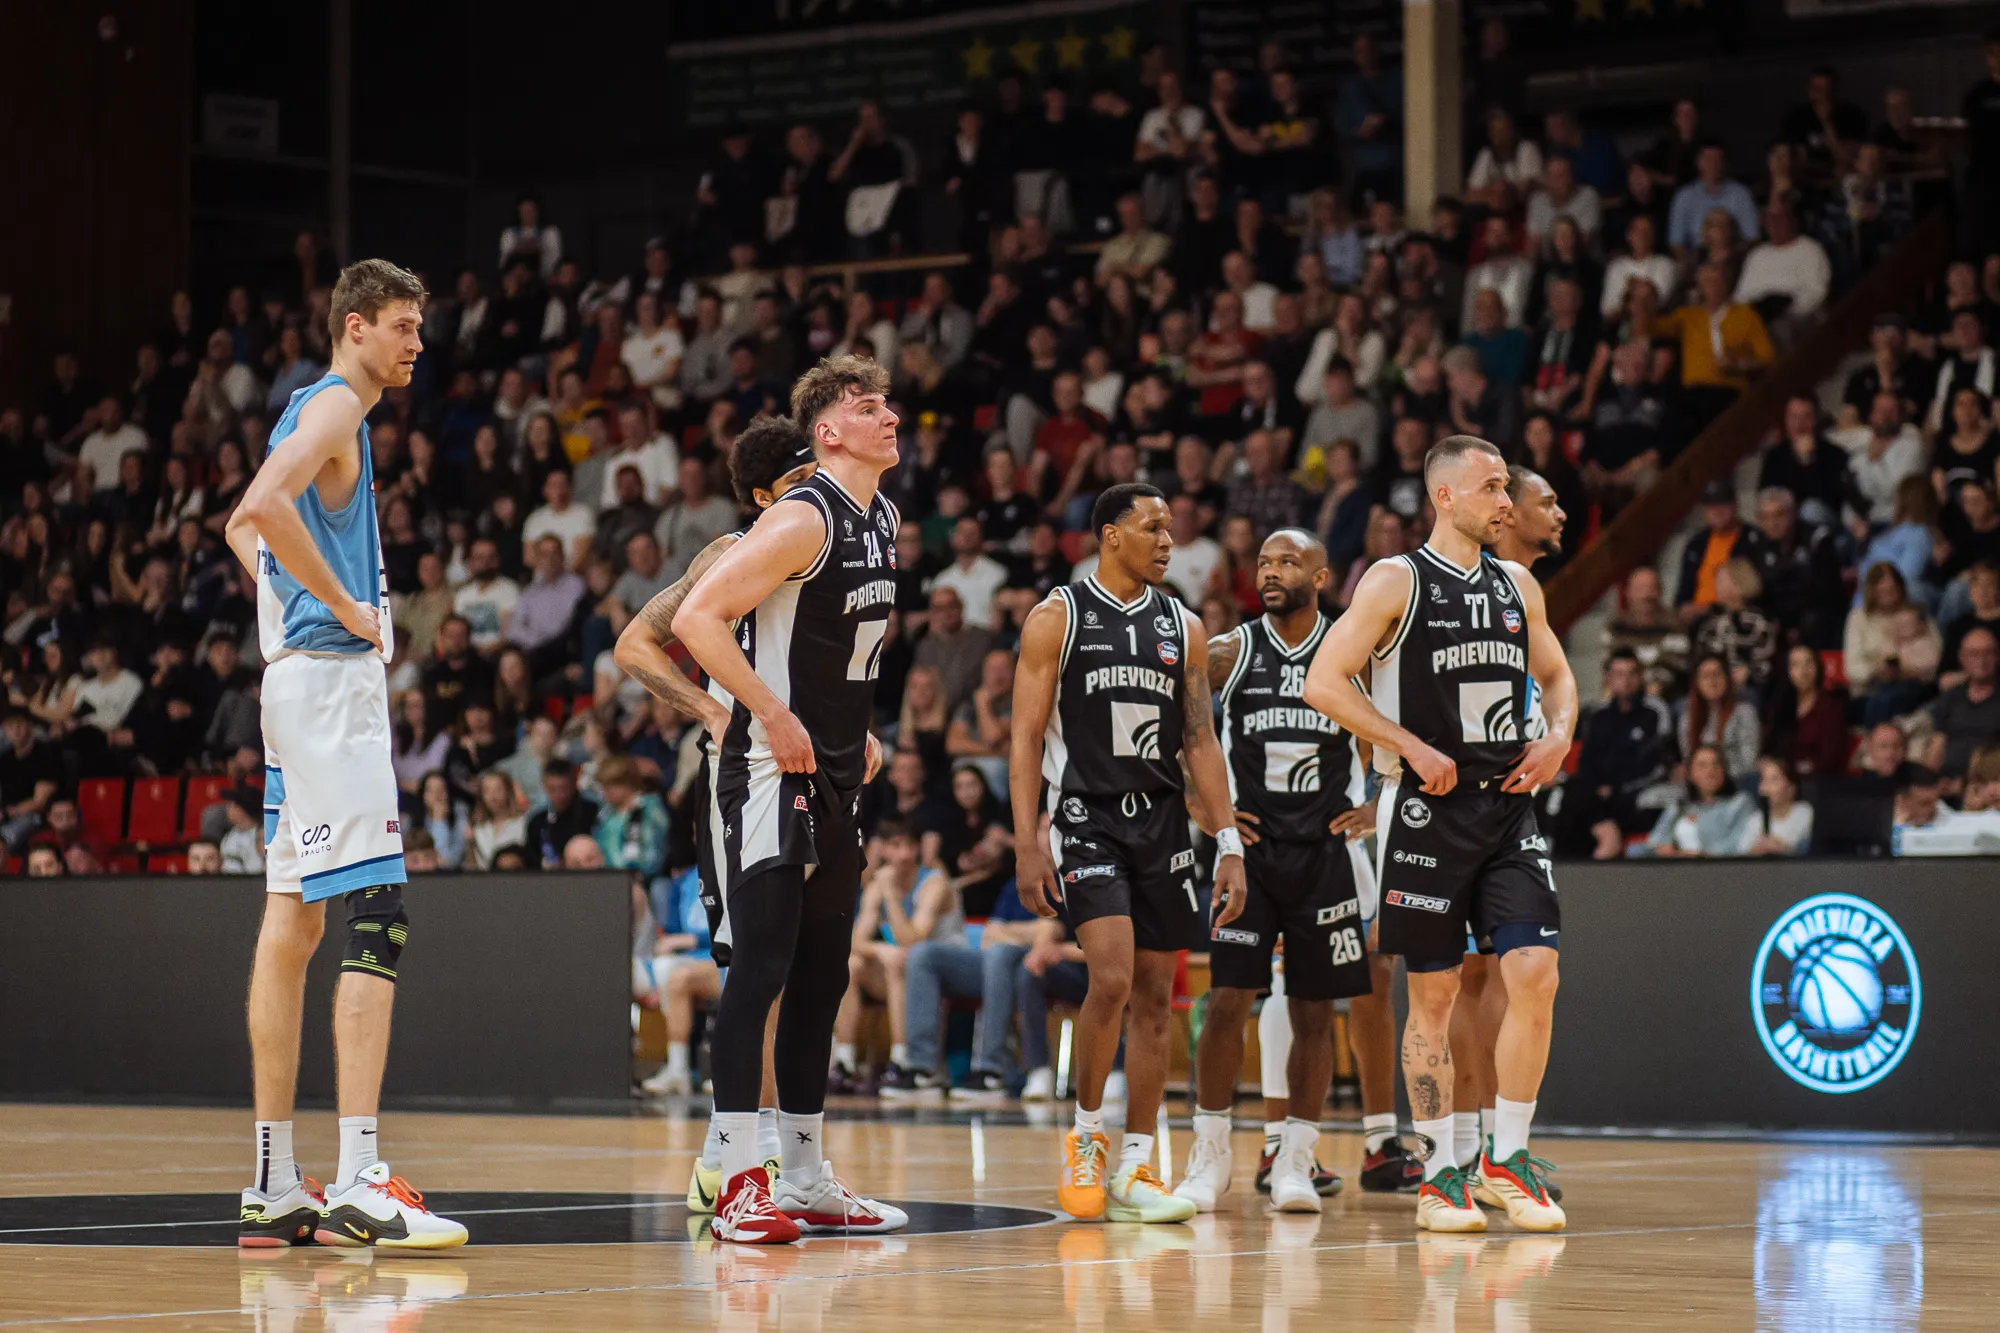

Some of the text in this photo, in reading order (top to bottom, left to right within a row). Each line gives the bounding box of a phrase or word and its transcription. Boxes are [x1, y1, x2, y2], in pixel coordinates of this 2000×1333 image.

[863, 531, 883, 568] 24
[1463, 593, 1491, 629] 77
[1079, 644, 1113, 652] PARTNERS
[1125, 624, 1138, 656] 1
[1432, 641, 1525, 674] PRIEVIDZA
[1085, 665, 1176, 700] PRIEVIDZA
[1278, 664, 1306, 698] 26
[1404, 853, 1437, 868] ATTIS
[1182, 878, 1199, 912] 1
[1403, 895, 1446, 911] TIPOS
[1218, 929, 1256, 943] TIPOS
[1329, 927, 1362, 966] 26
